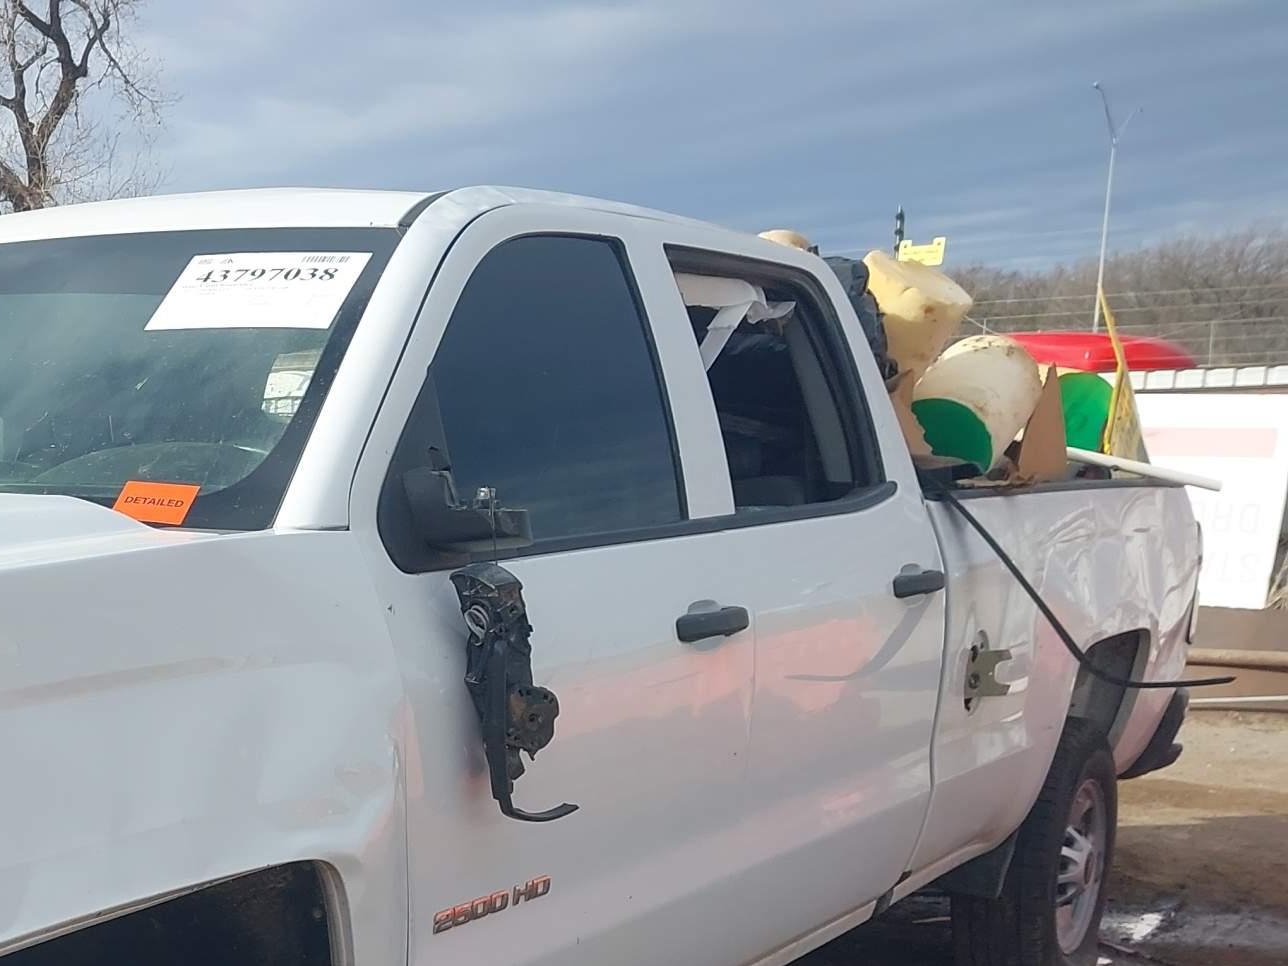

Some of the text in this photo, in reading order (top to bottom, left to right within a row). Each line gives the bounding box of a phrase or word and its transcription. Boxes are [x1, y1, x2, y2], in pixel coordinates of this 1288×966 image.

[195, 267, 339, 283] 43797038
[124, 496, 184, 508] DETAILED
[432, 875, 551, 935] 2500 HD
